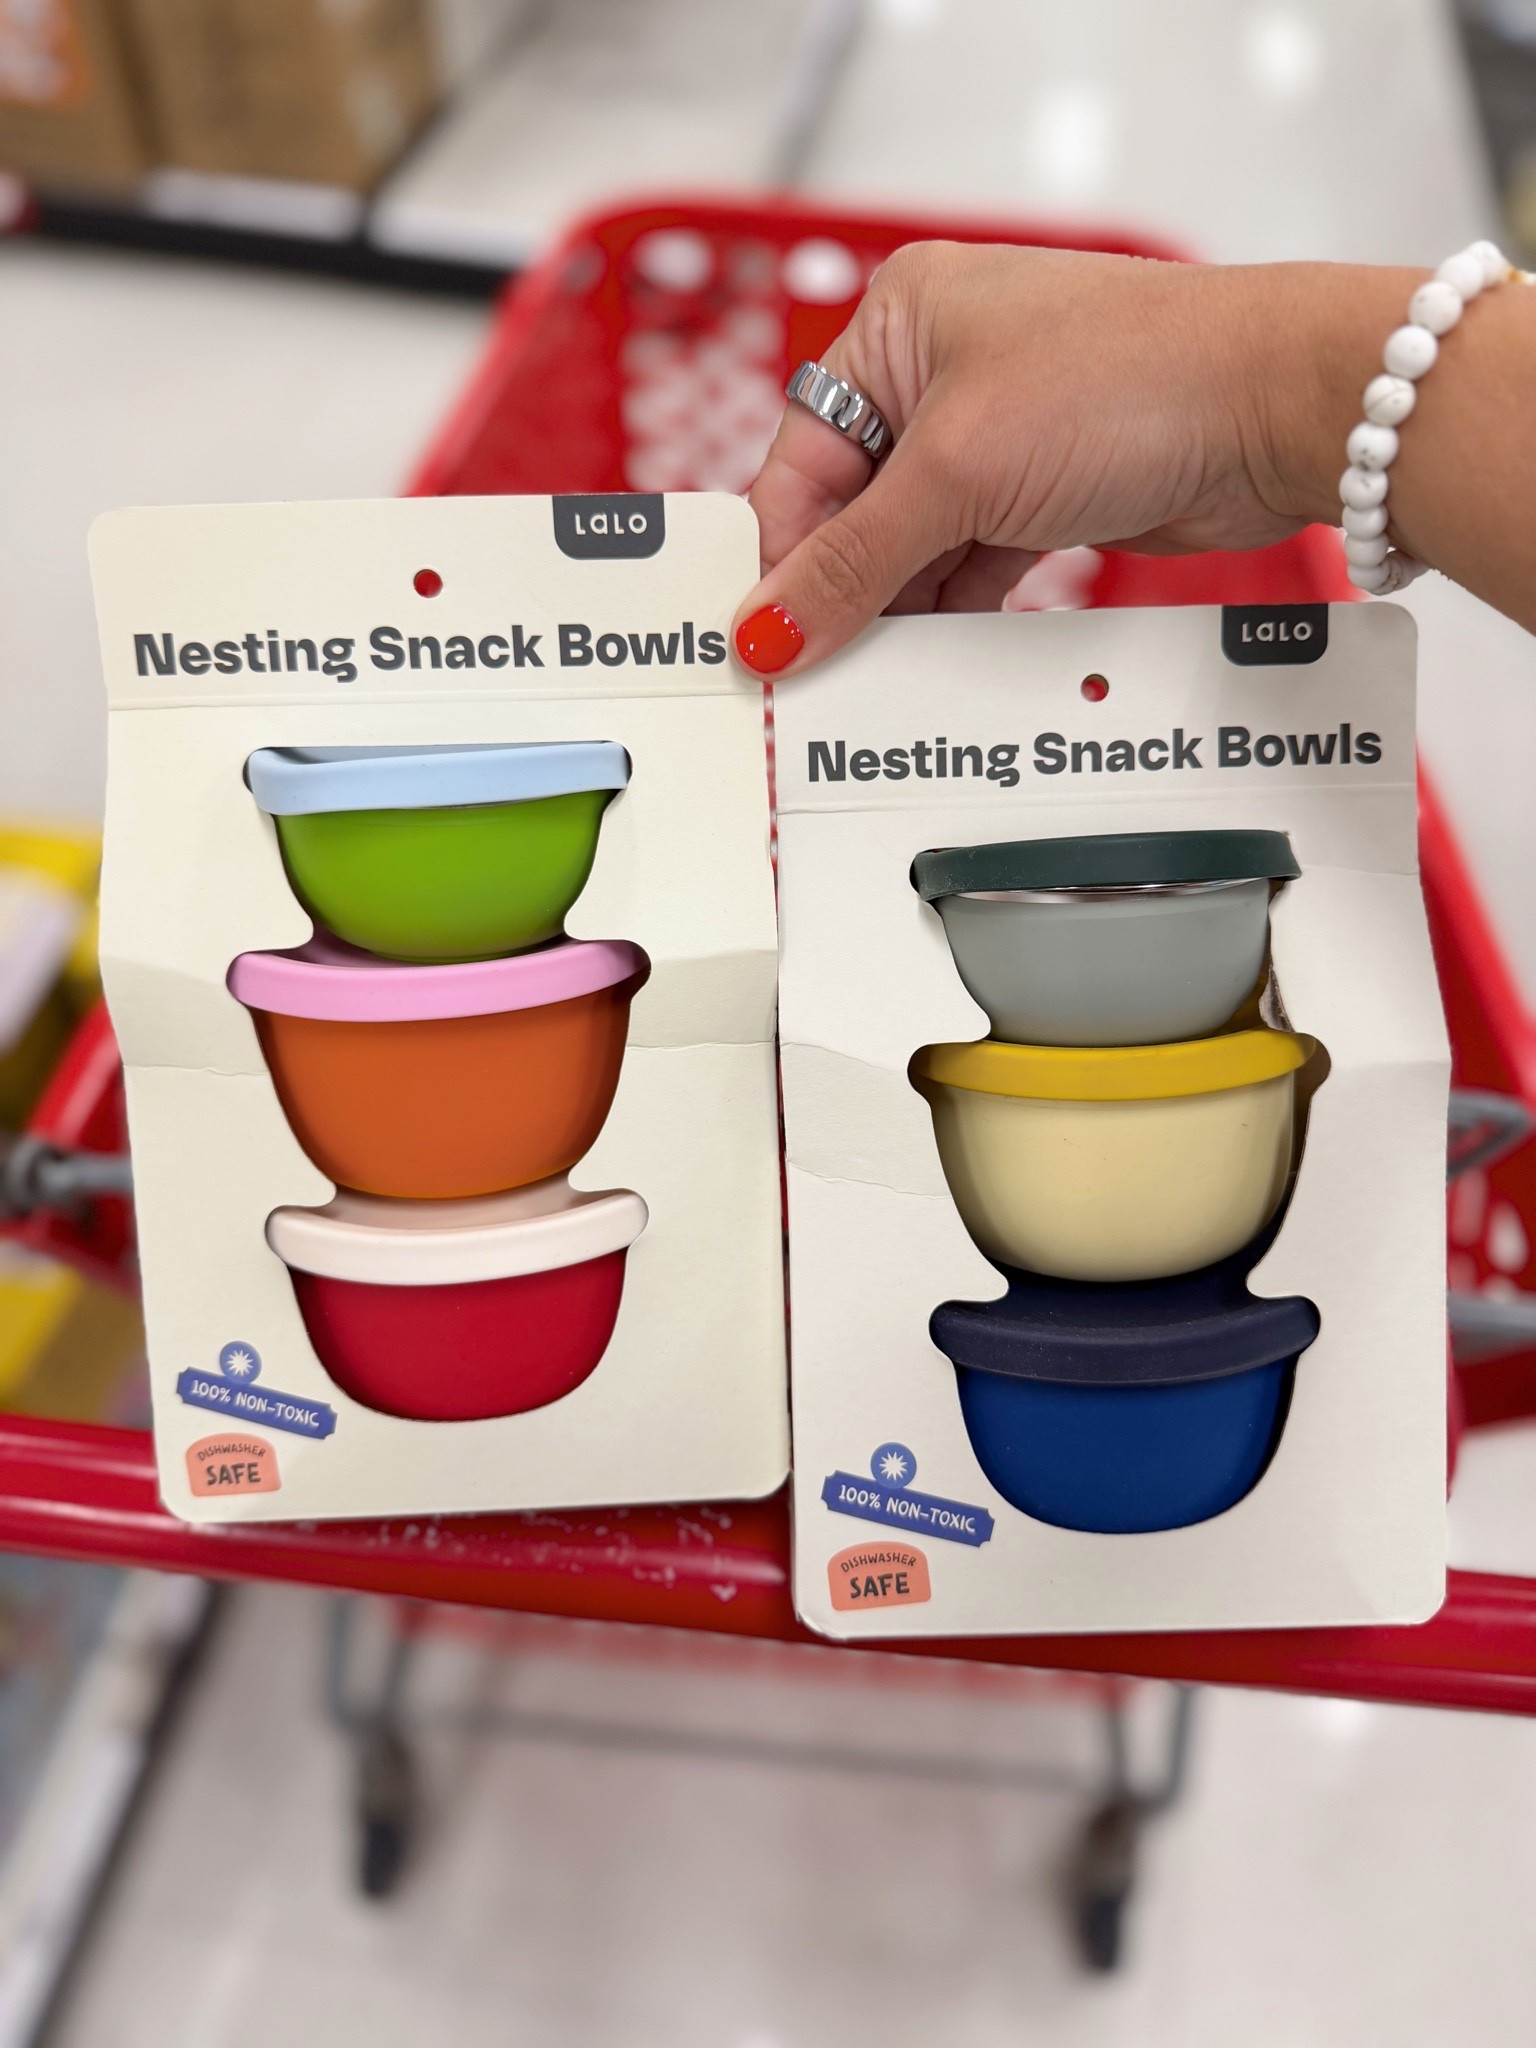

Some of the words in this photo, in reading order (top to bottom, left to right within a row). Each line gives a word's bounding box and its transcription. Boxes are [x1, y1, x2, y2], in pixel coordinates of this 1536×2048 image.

[133, 629, 356, 683] Nesting
[369, 625, 544, 670] Snack
[558, 622, 728, 667] Bowls
[807, 737, 1020, 789] Nesting
[1033, 728, 1203, 774] Snack
[1217, 723, 1383, 769] Bowls
[191, 1379, 230, 1402] 100%
[235, 1391, 319, 1427] NON-TOXIC
[197, 1443, 265, 1461] DISHWASHER
[206, 1462, 261, 1485] SAFE
[838, 1484, 881, 1508] 100%
[886, 1496, 975, 1532] NON-TOXIC
[840, 1551, 916, 1573] DISHWASHER
[849, 1572, 909, 1598] SAFE
